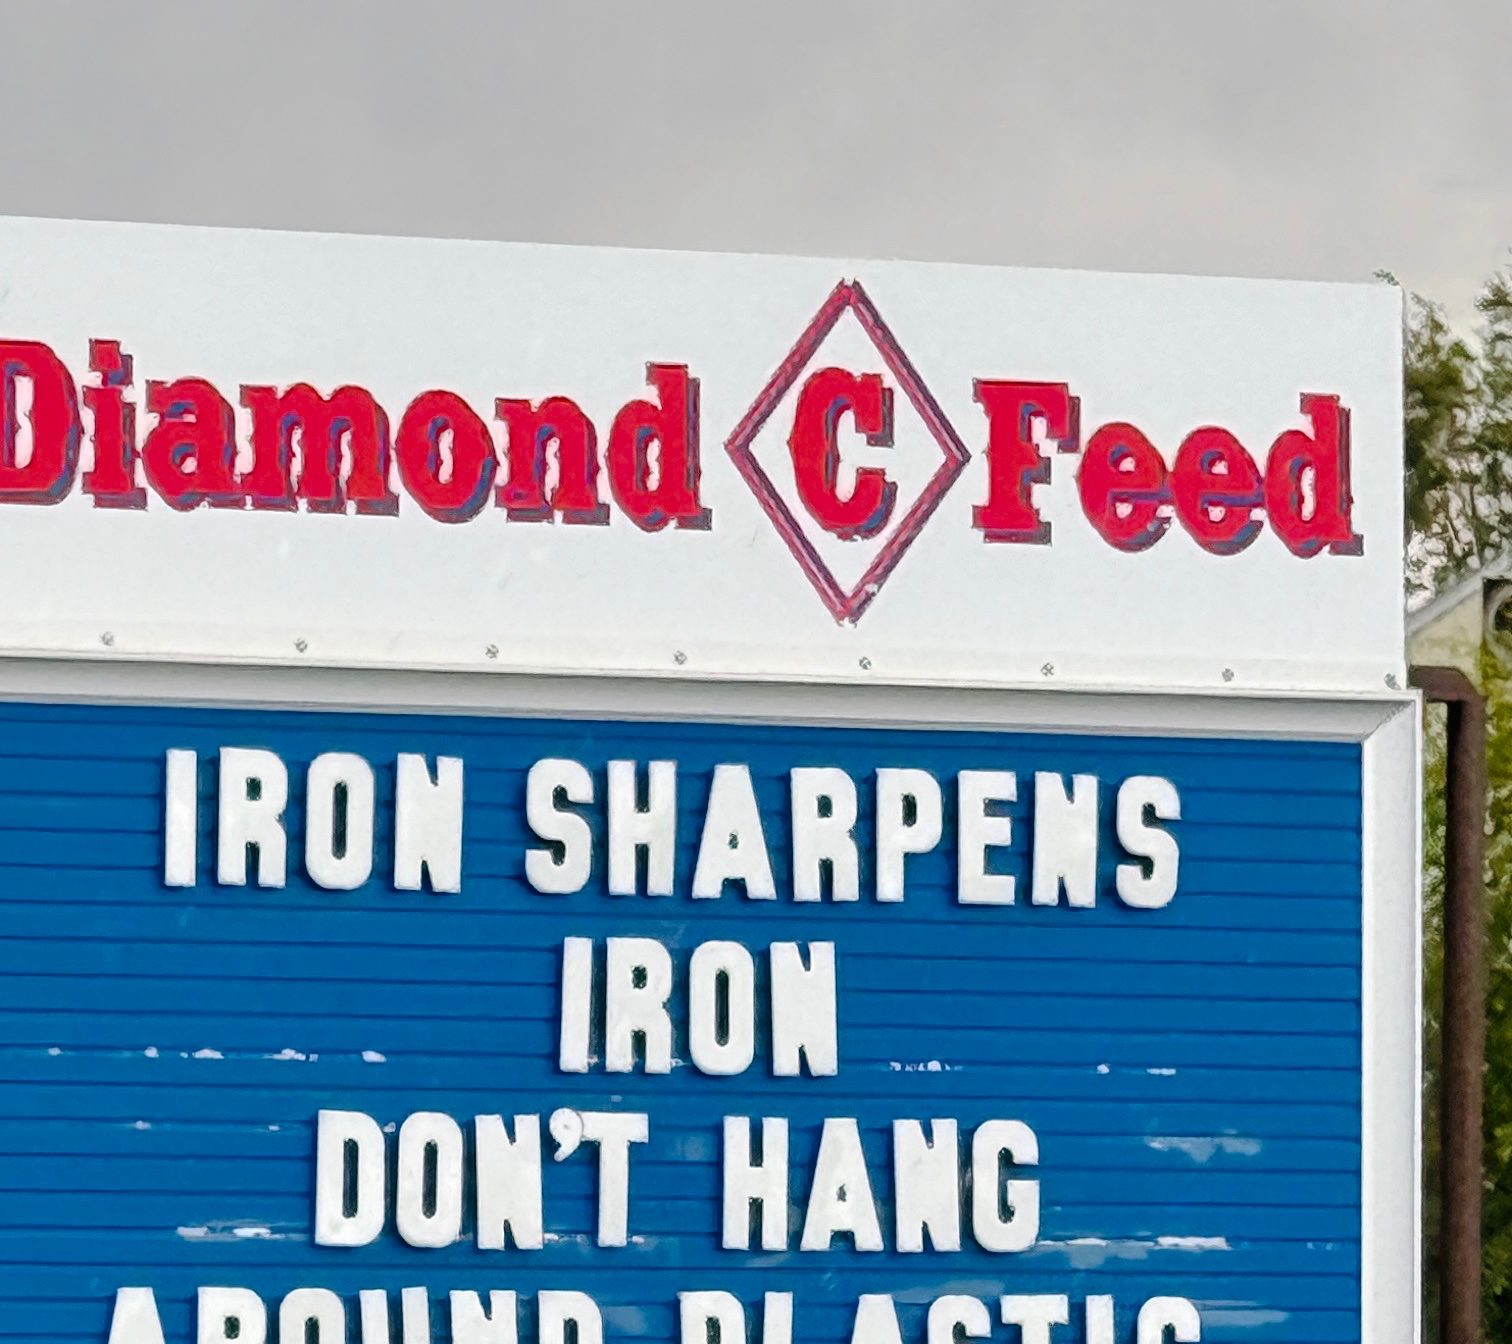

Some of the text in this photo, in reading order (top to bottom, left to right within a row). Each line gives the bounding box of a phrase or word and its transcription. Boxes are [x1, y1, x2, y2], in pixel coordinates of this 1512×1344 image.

[787, 366, 896, 541] C
[973, 379, 1364, 557] Feed
[165, 746, 1181, 908] IRON SHARPENS
[559, 936, 838, 1077] IRON
[315, 1108, 1040, 1253] DON'T HANG
